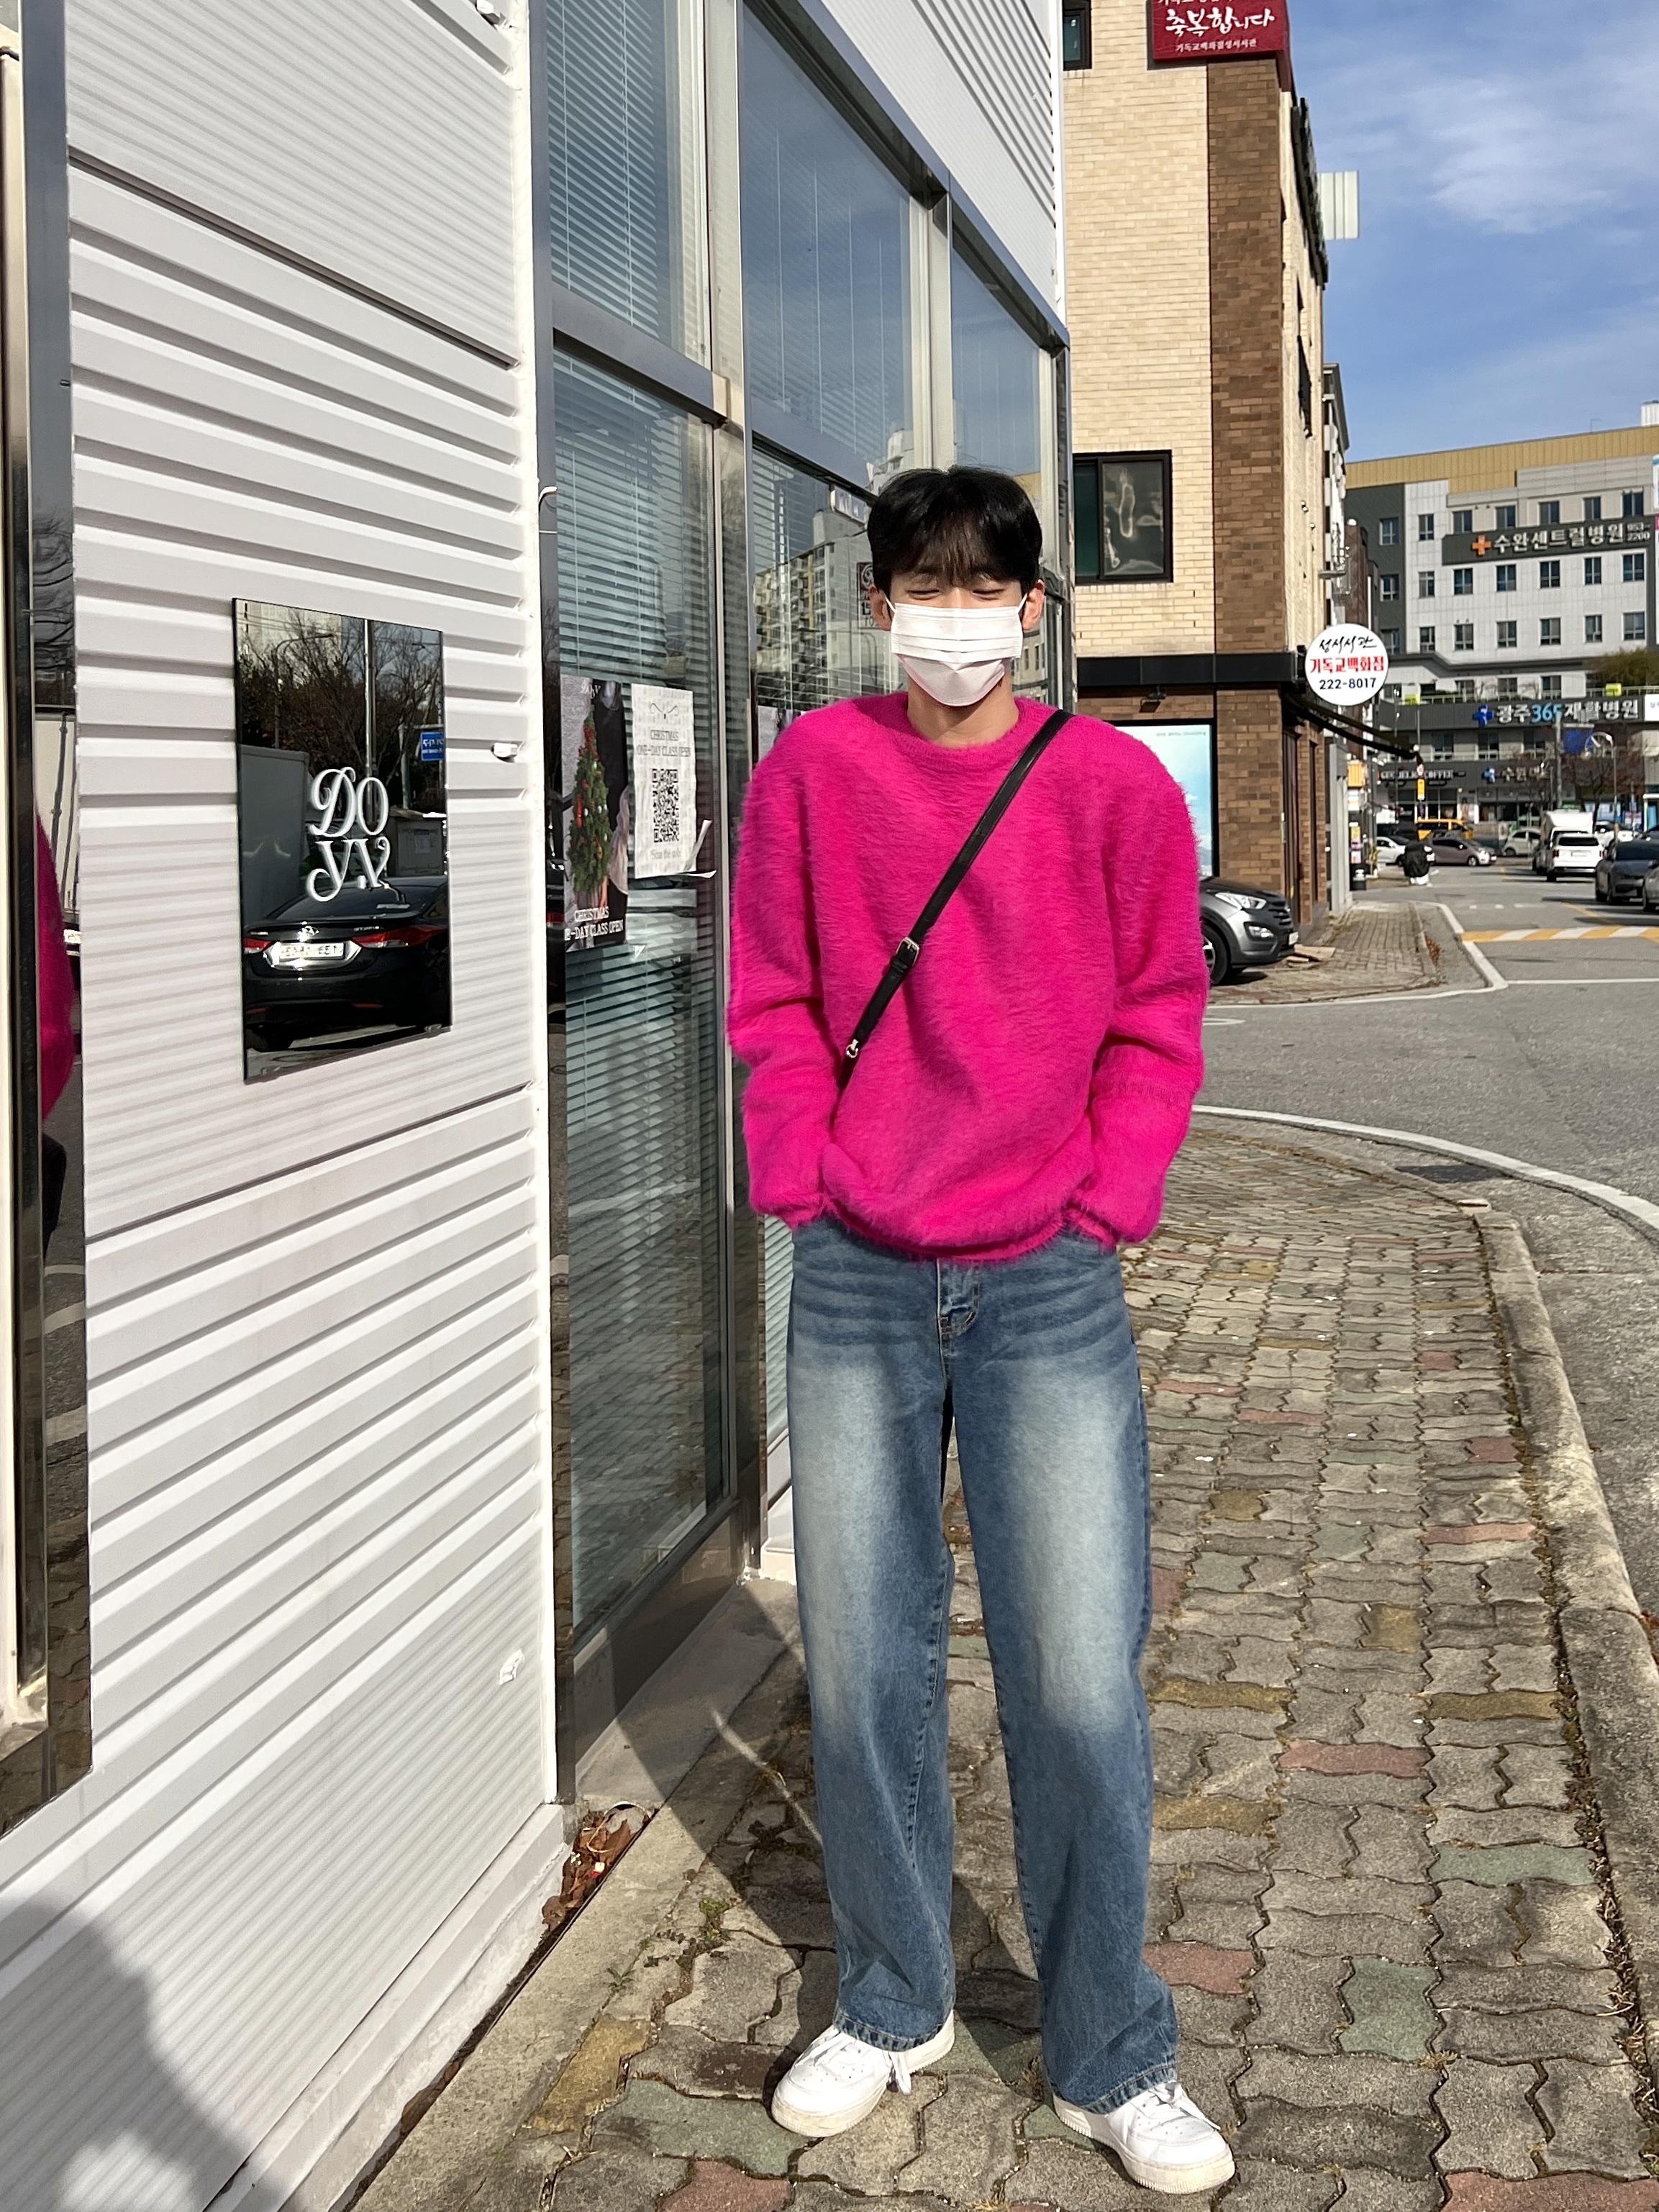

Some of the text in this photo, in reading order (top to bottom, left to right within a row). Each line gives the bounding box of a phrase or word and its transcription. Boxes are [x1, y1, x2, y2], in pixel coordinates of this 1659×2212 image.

[1165, 6, 1276, 37] 축복합니다
[1494, 523, 1623, 553] 수완센트럴병원
[1319, 635, 1378, 654] 성서서관
[1310, 655, 1384, 673] 기독교백화점
[1319, 677, 1377, 690] 222-8017
